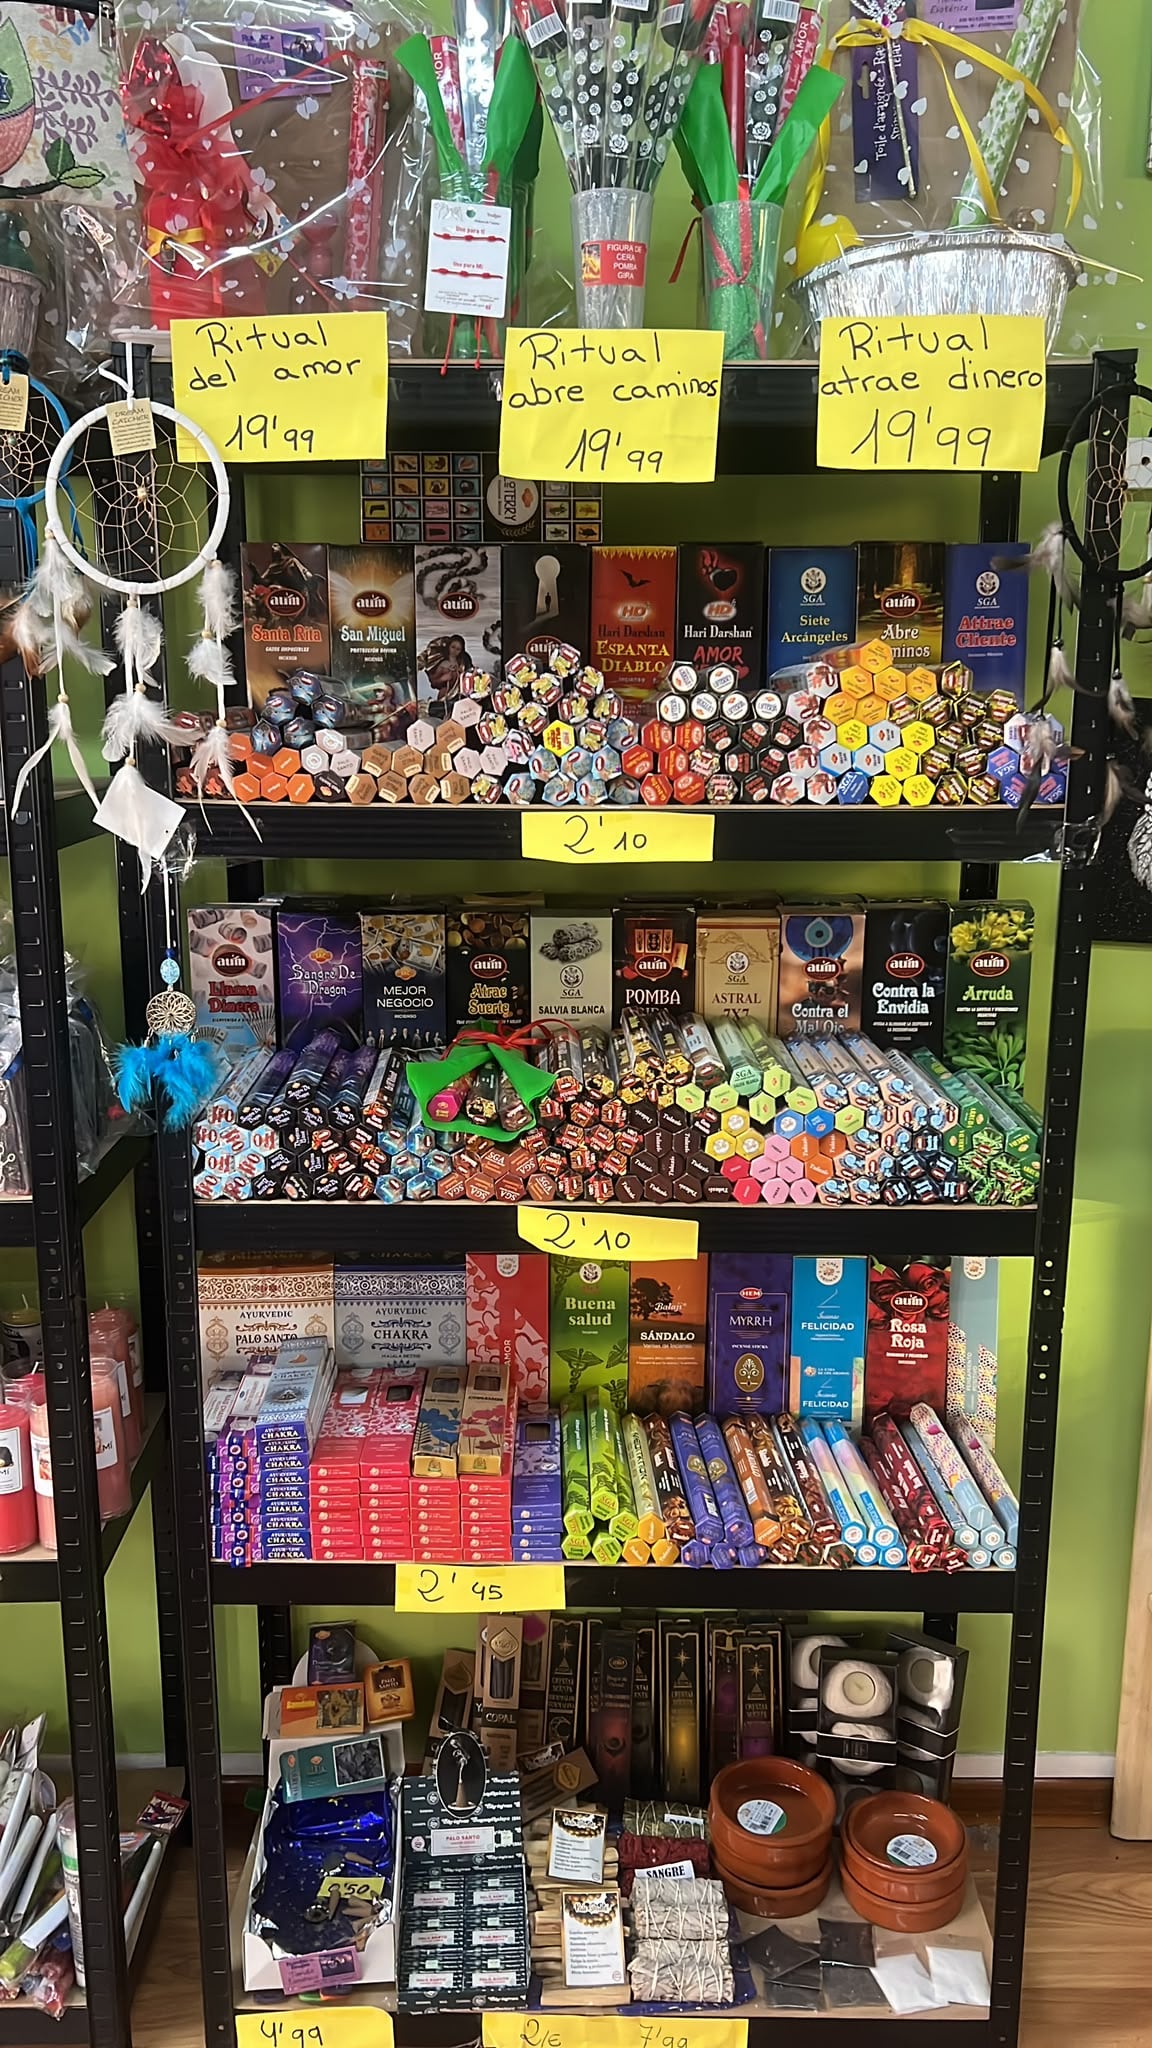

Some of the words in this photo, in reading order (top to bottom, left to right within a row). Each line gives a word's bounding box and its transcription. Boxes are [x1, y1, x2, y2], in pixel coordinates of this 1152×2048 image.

[795, 22, 808, 58] AMOR
[607, 244, 633, 252] FIGURA
[616, 253, 635, 261] CERA
[613, 262, 637, 271] POMBA
[617, 272, 634, 280] GIRA
[192, 317, 331, 362] Ritual
[839, 318, 987, 364] Ritual
[520, 328, 663, 369] Ritual
[190, 355, 236, 390] del
[275, 360, 360, 379] amor
[820, 364, 921, 394] atrae
[949, 358, 1043, 390] dinero
[509, 378, 584, 408] abre
[612, 374, 718, 402] caminos
[802, 594, 823, 603] SGA
[977, 597, 998, 606] SGA
[621, 605, 647, 618] HD
[707, 603, 732, 616] HD
[799, 615, 830, 627] Siete
[958, 615, 1015, 631] Attrae
[251, 624, 289, 643] Santa
[294, 624, 322, 642] Rita
[341, 626, 363, 642] San
[367, 626, 406, 645] Miguel
[598, 626, 620, 638] Hari
[623, 625, 665, 638] Darshan
[684, 625, 707, 639] Hari
[709, 624, 752, 639] Darshan
[781, 629, 848, 644] Arcángeles
[880, 624, 919, 640] Abre
[956, 632, 1016, 647] Cliente
[596, 640, 670, 657] ESPANTA
[693, 645, 744, 664] AMOR
[601, 658, 666, 674] DIABLO
[565, 815, 646, 854] 2'10
[291, 965, 335, 980] Sangre
[338, 964, 356, 979] De
[727, 974, 746, 983] SGA
[208, 981, 258, 997] Llama
[305, 981, 347, 997] Dragon
[384, 986, 426, 996] MEJOR
[471, 983, 507, 999] Atrae
[561, 988, 581, 997] SGA
[872, 983, 918, 999] Contra
[922, 982, 936, 998] la
[962, 985, 1013, 1002] Arruda
[377, 998, 434, 1008] NEGOCIO
[626, 989, 681, 1005] POMBA
[712, 993, 761, 1004] ASTRAL
[208, 998, 259, 1013] Dinero
[468, 1000, 510, 1015] Suerte
[538, 1005, 569, 1015] SALVIA
[571, 1004, 605, 1015] BLANCA
[792, 1003, 833, 1018] Contra
[838, 1003, 849, 1017] el
[876, 1000, 929, 1015] Envidia
[795, 1020, 819, 1033] Mal
[735, 1070, 752, 1078] SGA
[541, 1209, 634, 1254] 2'10
[565, 1297, 616, 1310] Buena
[654, 1301, 682, 1313] Balaji
[240, 1310, 293, 1319] AYURVEDIC
[375, 1306, 427, 1315] AYURVEDIC
[569, 1313, 612, 1326] salud
[729, 1316, 772, 1328] MYRRH
[801, 1322, 854, 1331] FELICIDAD
[890, 1319, 927, 1334] Rosa
[235, 1333, 262, 1346] PALO
[374, 1330, 429, 1340] CHAKRA
[640, 1330, 695, 1341] SÁNDALO
[891, 1334, 925, 1350] Roja
[504, 1339, 512, 1366] AMOR
[802, 1400, 849, 1408] FELICIDAD
[261, 1430, 299, 1440] CHAKRA
[264, 1444, 301, 1452] CHAKRA
[265, 1460, 303, 1468] CHAKRA
[266, 1476, 303, 1484] CHAKRA
[266, 1490, 304, 1498] CHAKRA
[266, 1505, 304, 1513] CHAKRA
[266, 1520, 303, 1529] CHAKRA
[267, 1535, 304, 1544] CHAKRA
[268, 1551, 304, 1559] CHAKRA
[418, 1566, 502, 1602] 2'45
[485, 1712, 515, 1724] COPAL
[646, 1865, 686, 1878] SANGRE
